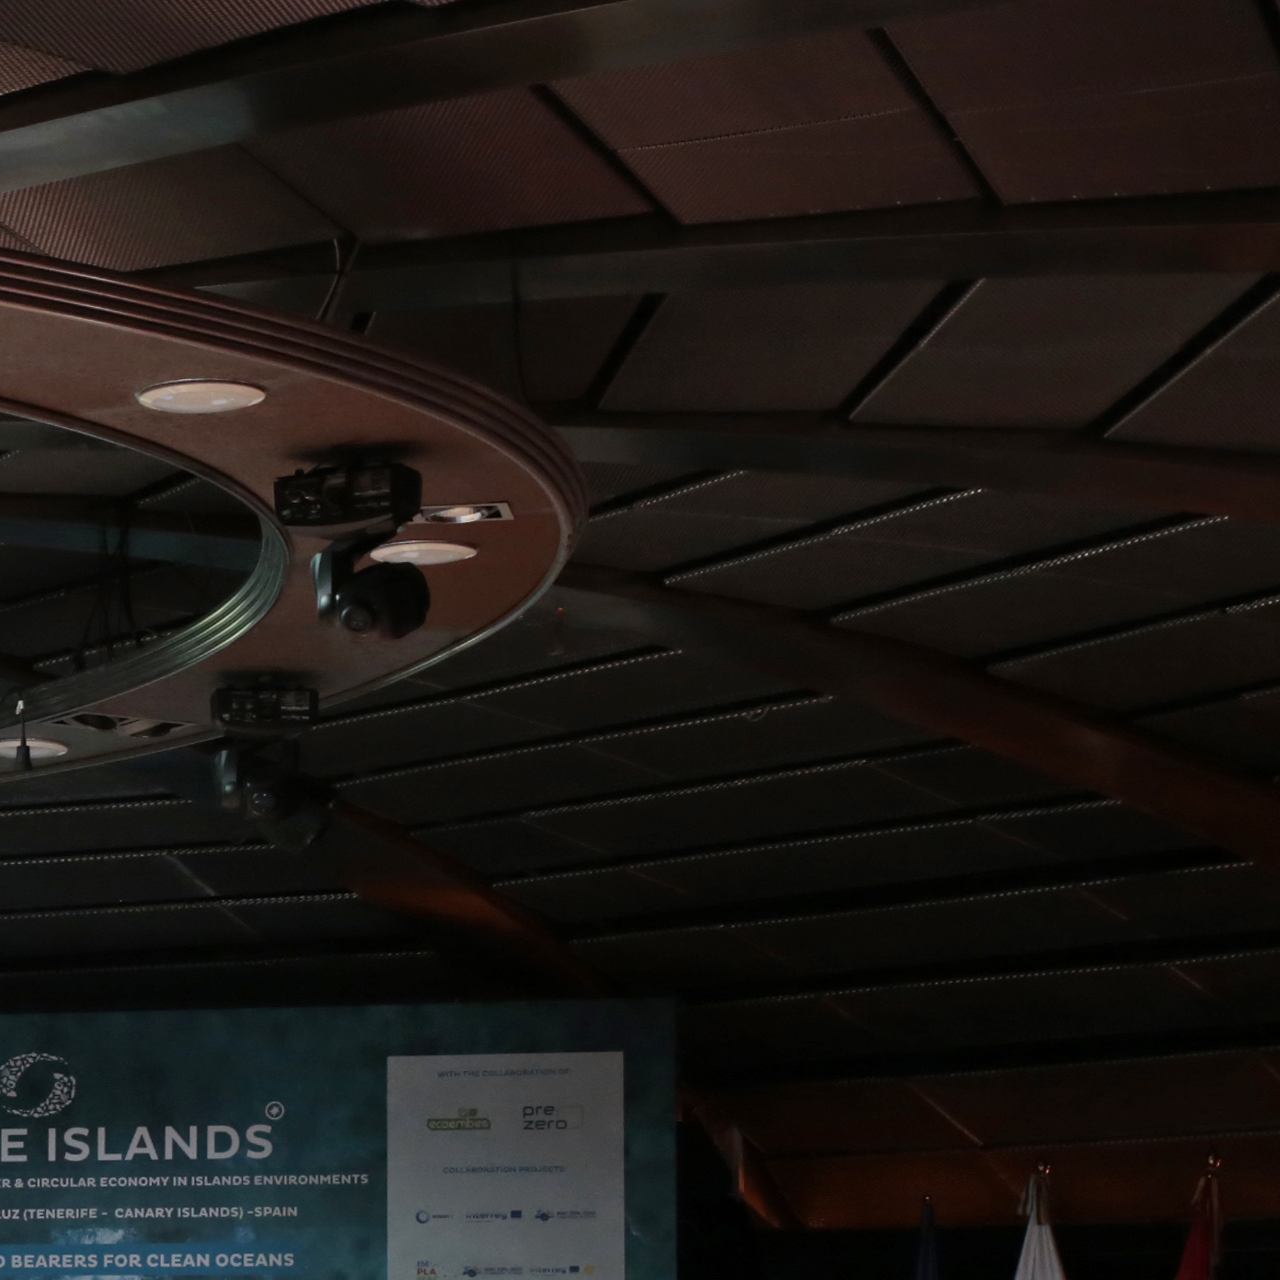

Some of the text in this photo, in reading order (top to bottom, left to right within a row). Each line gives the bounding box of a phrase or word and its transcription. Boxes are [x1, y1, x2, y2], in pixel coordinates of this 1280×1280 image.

[523, 1105, 555, 1118] pre
[523, 1119, 567, 1130] zero
[48, 1124, 274, 1161] ISLANDS
[14, 1178, 24, 1188] &
[28, 1177, 96, 1188] CIRCULAR
[100, 1176, 169, 1187] ECONOMY
[173, 1176, 187, 1186] IN
[191, 1175, 250, 1186] ISLANDS
[254, 1174, 369, 1185] ENVIRONMENTS
[23, 1209, 98, 1221] (TENERIFE
[115, 1207, 174, 1219] CANARY
[178, 1207, 243, 1219] ISLANDS)
[11, 1254, 98, 1268] BEARERS
[103, 1254, 142, 1268] FOR
[146, 1254, 210, 1267] CLEAN
[216, 1253, 294, 1267] OCEANS
